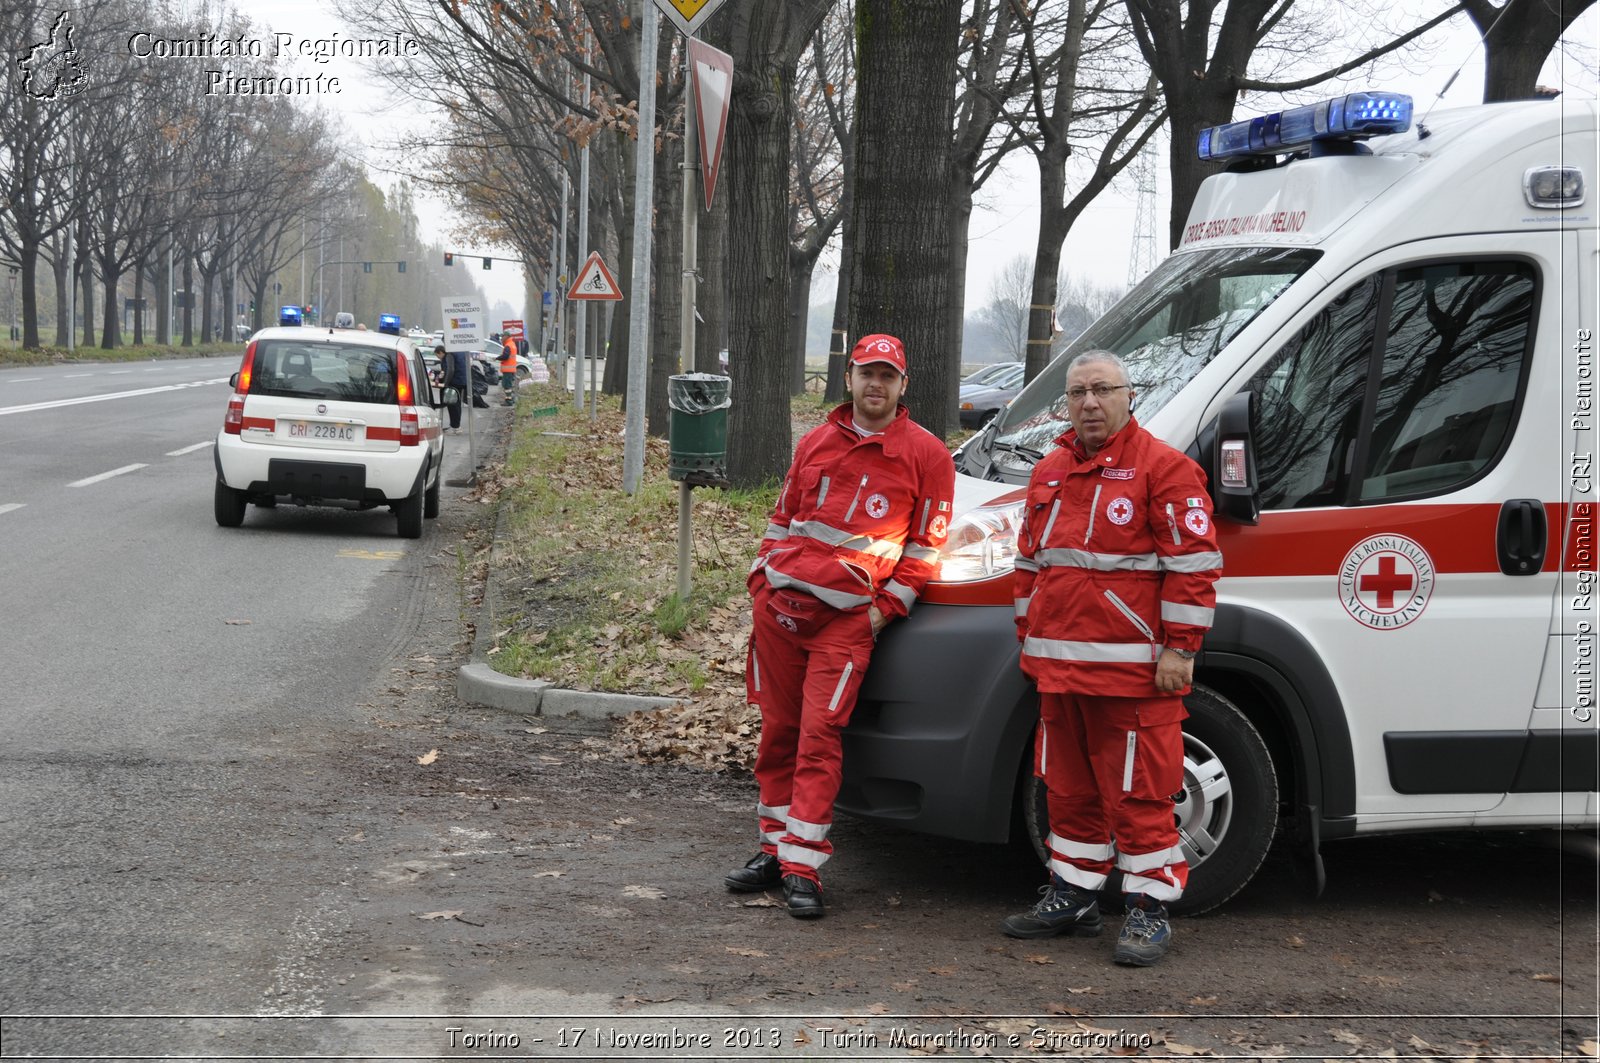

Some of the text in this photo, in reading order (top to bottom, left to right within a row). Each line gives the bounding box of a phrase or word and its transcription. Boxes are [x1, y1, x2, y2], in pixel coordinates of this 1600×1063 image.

[1184, 210, 1306, 244] CROCE ROSSA ITALIANA NICHELINO
[290, 424, 353, 440] CRI 228 AC
[1342, 538, 1431, 586] CROCE ROSSA ITALIANA
[1344, 595, 1425, 627] NICHELINO
